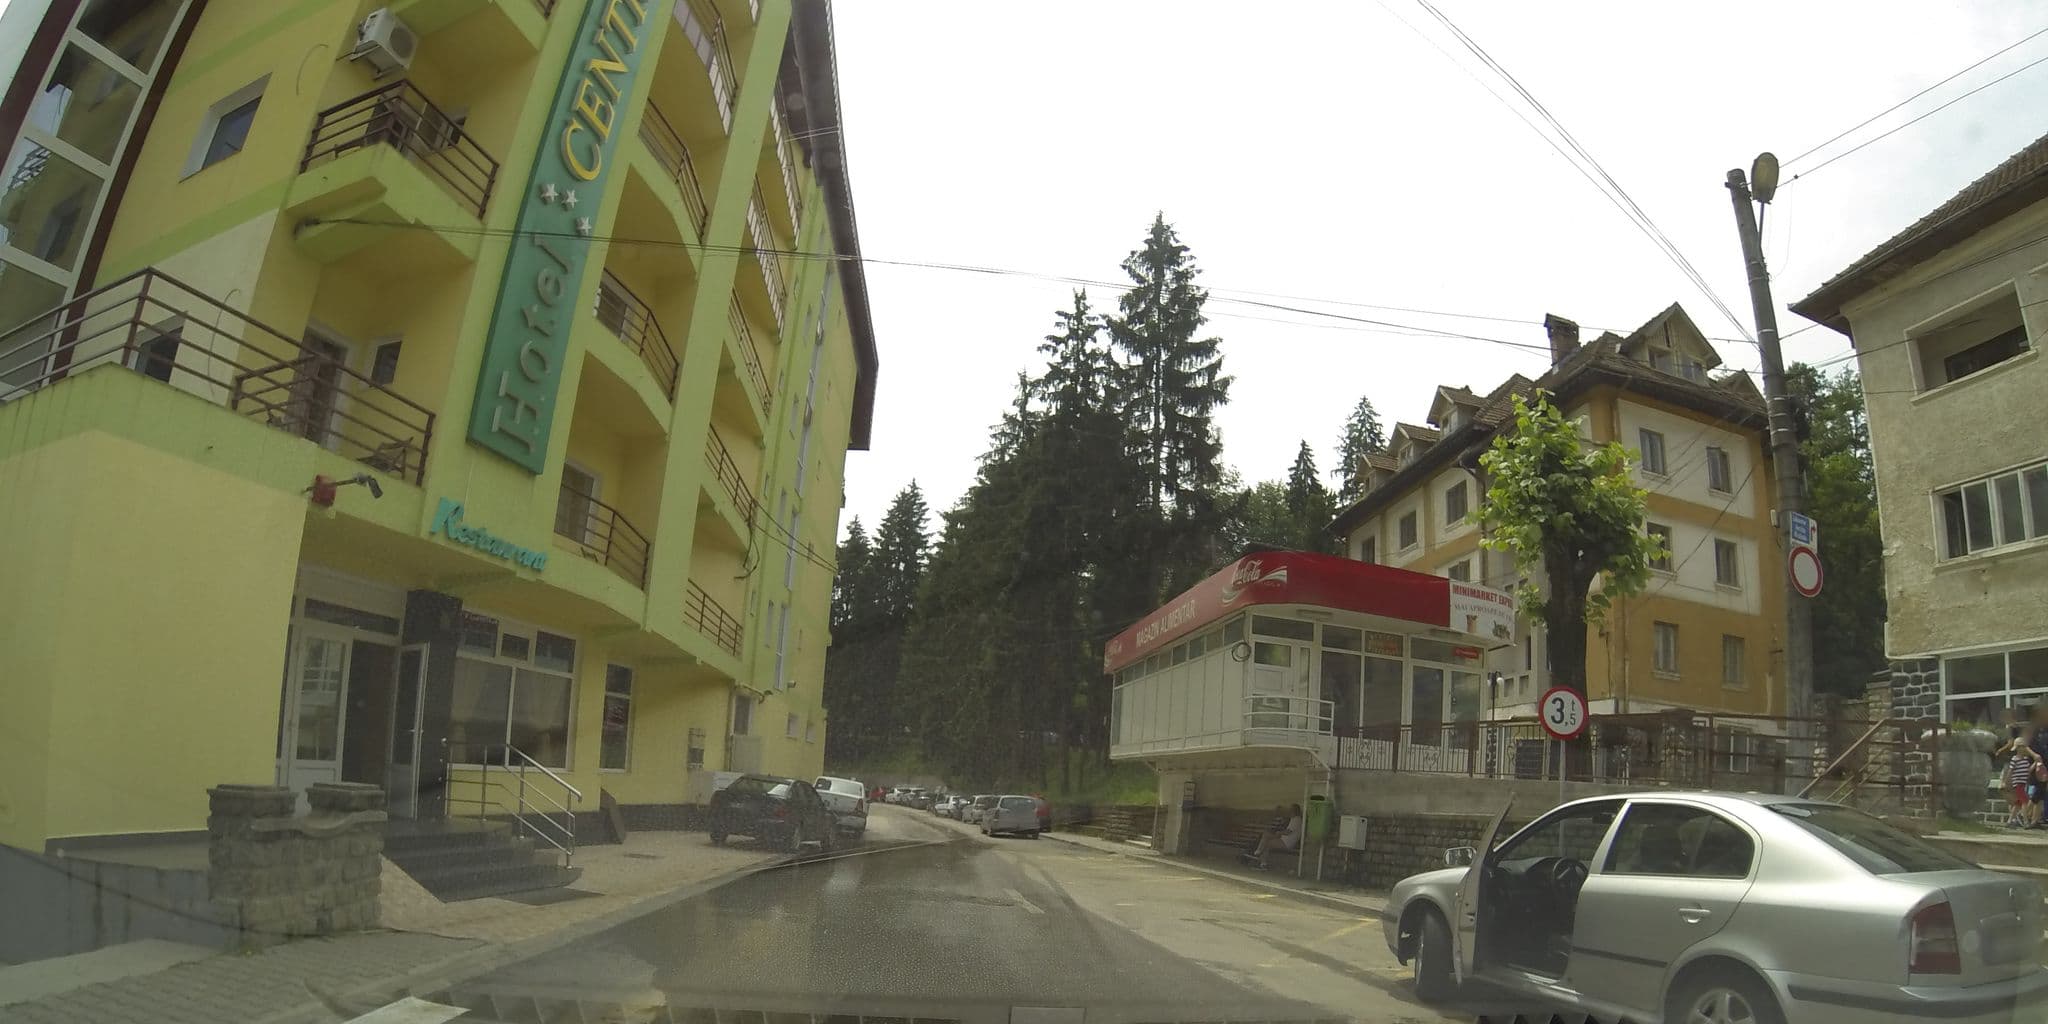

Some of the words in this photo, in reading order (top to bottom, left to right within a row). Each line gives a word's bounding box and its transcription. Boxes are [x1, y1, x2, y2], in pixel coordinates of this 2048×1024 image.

[490, 234, 577, 456] Hotel
[1452, 584, 1498, 603] MINIMARKET
[1136, 621, 1160, 648] MAGAZIN
[1159, 599, 1197, 633] ALIMENTAR
